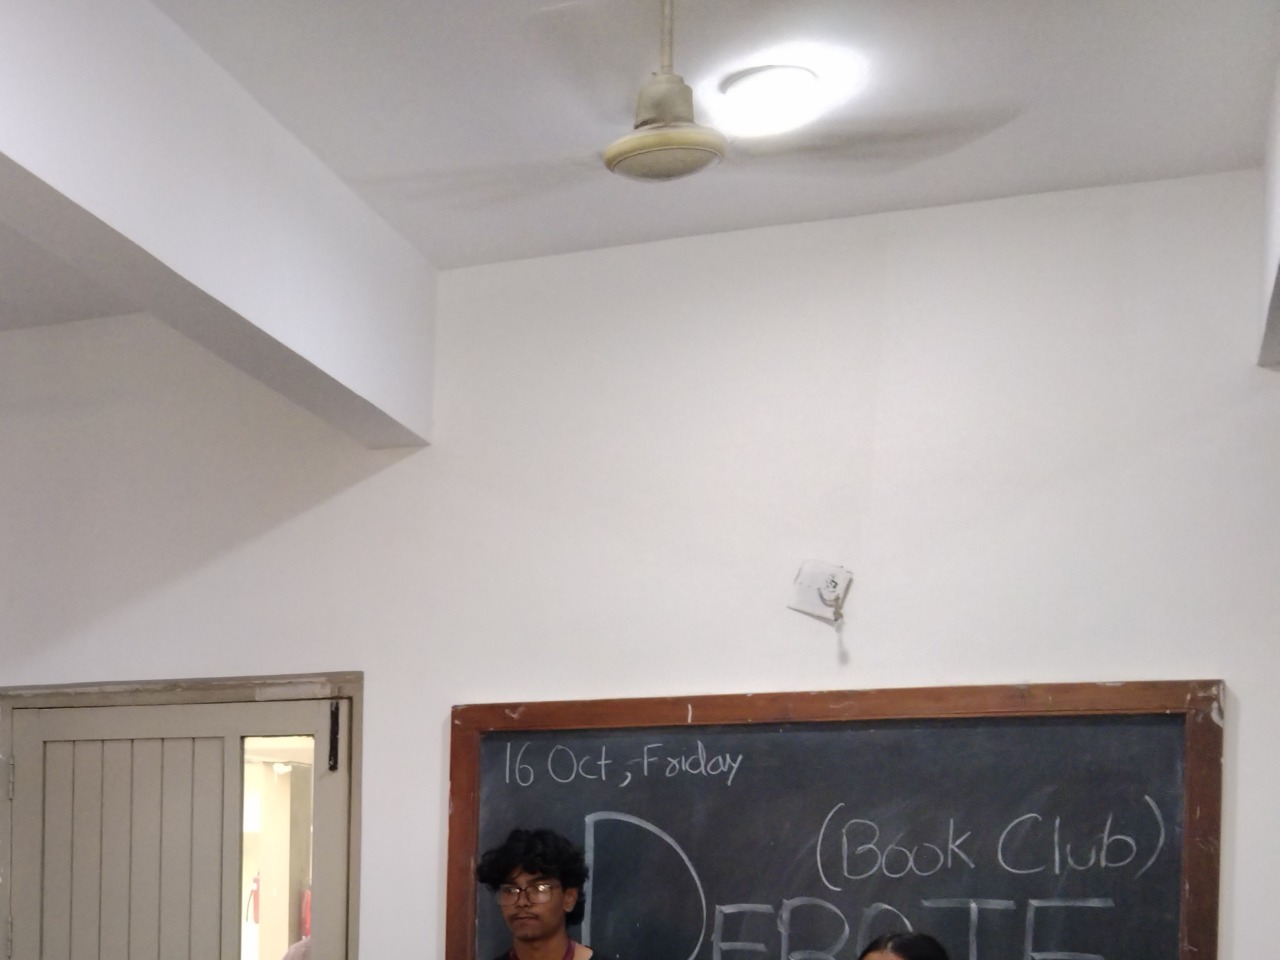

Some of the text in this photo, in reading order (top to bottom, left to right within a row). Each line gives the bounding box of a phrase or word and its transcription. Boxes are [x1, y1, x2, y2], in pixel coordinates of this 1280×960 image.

[504, 741, 535, 787] 16
[641, 738, 744, 787] Friday
[816, 794, 1165, 891] (Book Club)
